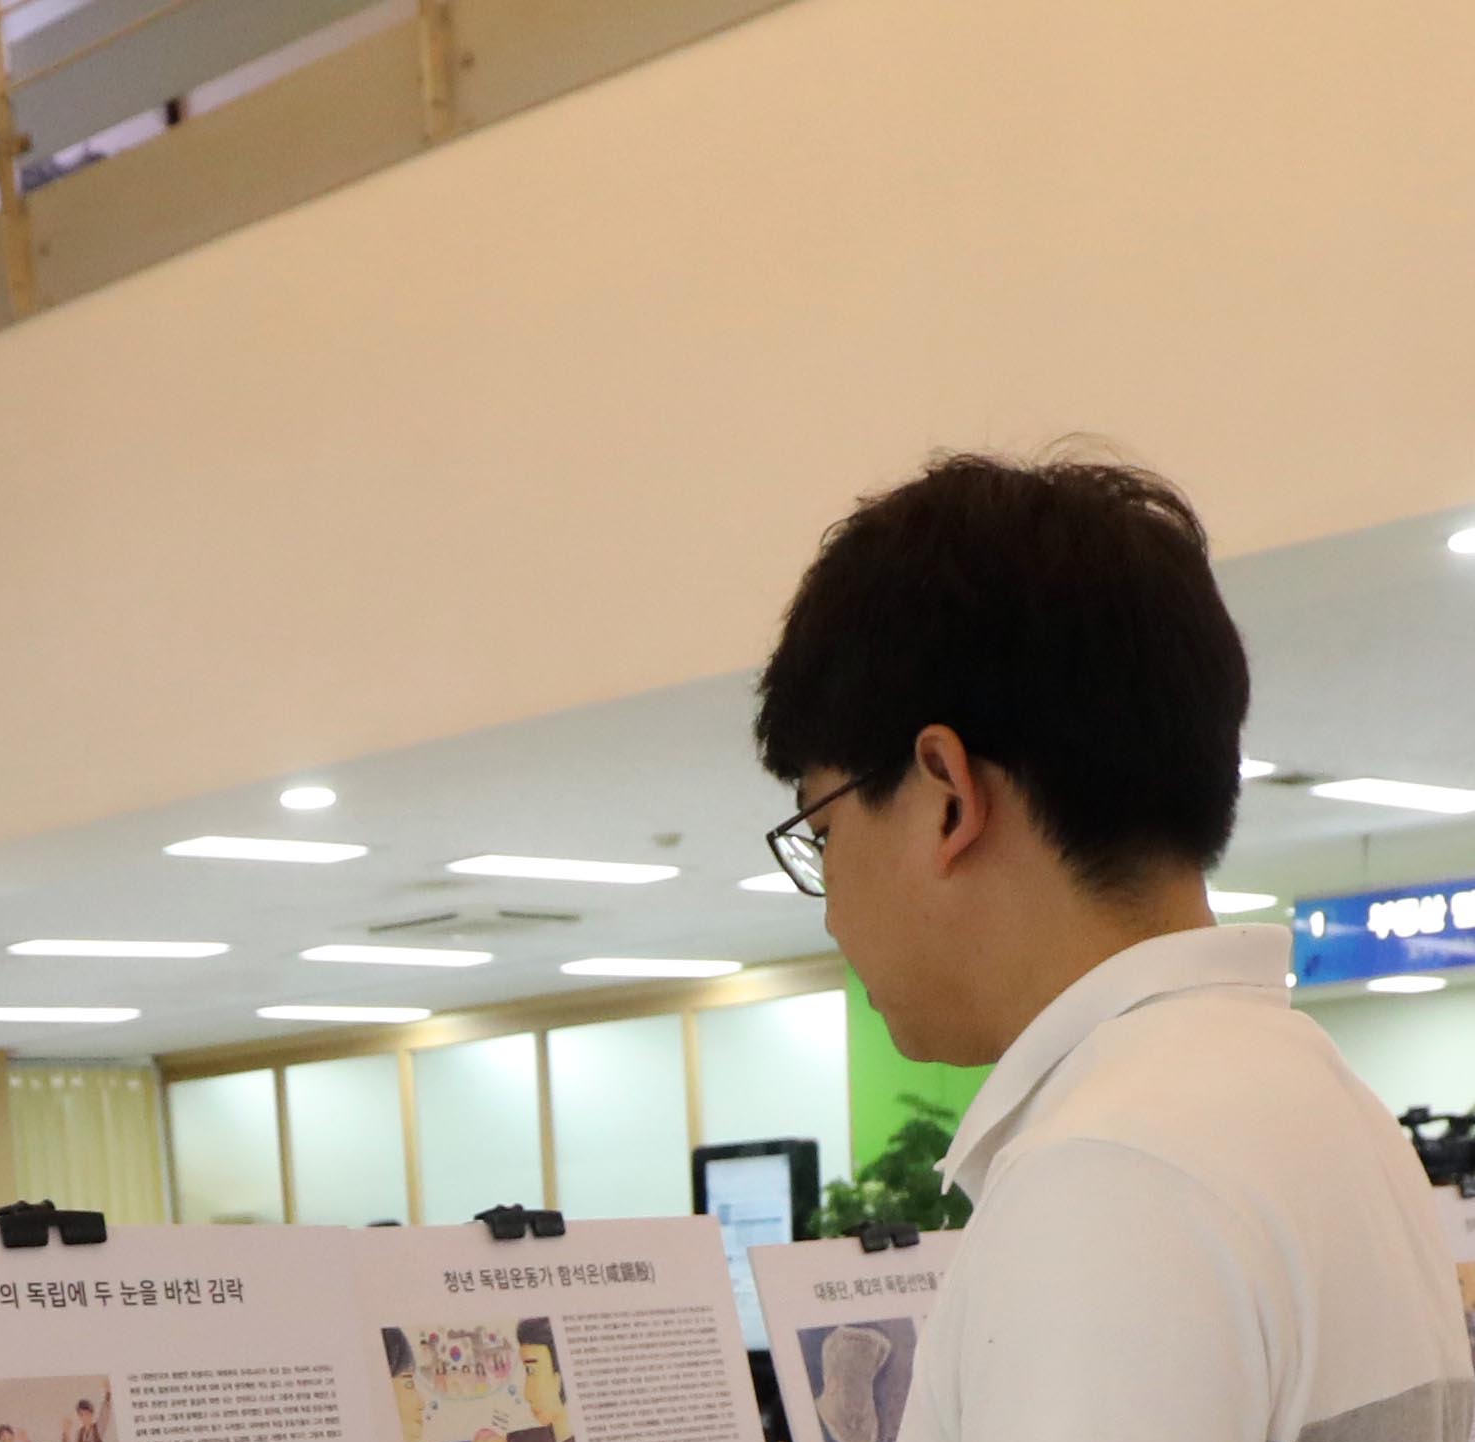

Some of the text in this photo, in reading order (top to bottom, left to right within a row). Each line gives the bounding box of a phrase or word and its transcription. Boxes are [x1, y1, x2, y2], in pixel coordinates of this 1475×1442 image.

[480, 1266, 553, 1290] 독립운동가
[27, 1281, 87, 1308] 독립에
[95, 1282, 112, 1306] 두
[120, 1280, 157, 1306] 눈을
[164, 1280, 201, 1304] 바친
[208, 1279, 243, 1303] 김락
